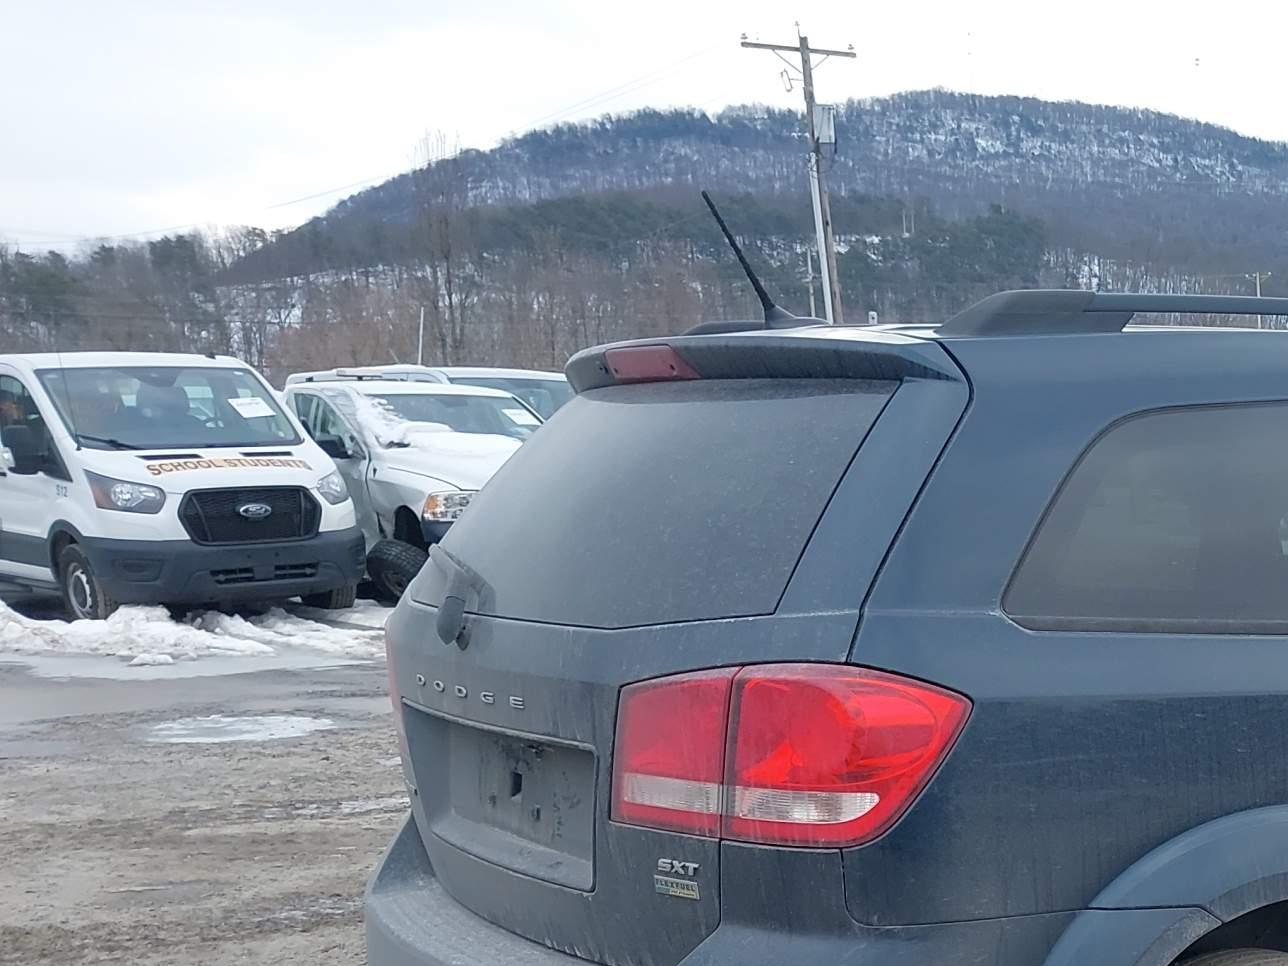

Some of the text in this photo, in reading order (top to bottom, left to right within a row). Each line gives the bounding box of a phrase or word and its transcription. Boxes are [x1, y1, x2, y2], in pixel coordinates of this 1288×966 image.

[146, 459, 224, 476] SCHOOL
[416, 673, 525, 709] DODGE
[657, 857, 700, 876] SXT
